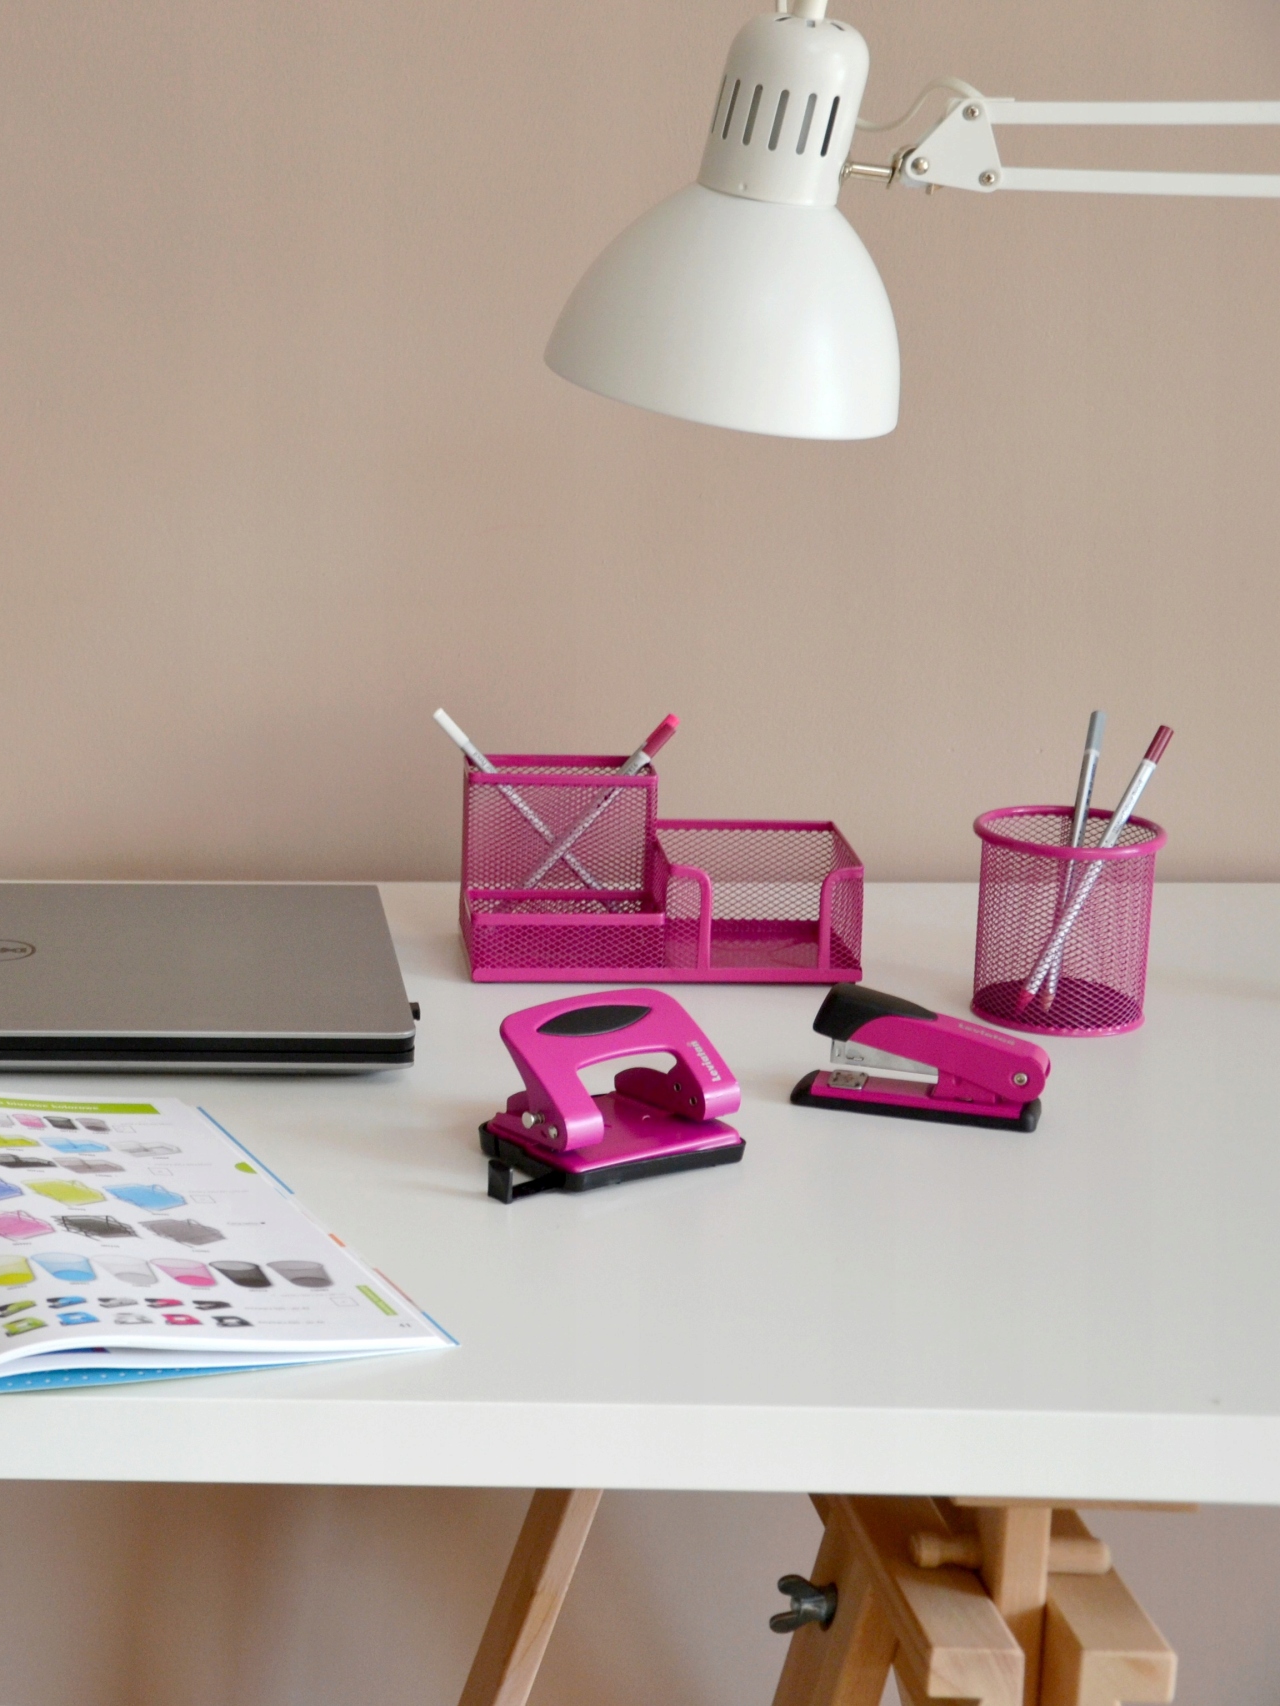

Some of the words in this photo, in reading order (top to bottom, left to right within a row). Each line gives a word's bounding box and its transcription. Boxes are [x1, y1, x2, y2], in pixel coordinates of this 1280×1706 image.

[689, 1040, 722, 1083] Leviatan
[6, 1099, 49, 1109] biurowe
[51, 1102, 100, 1111] kolorowe
